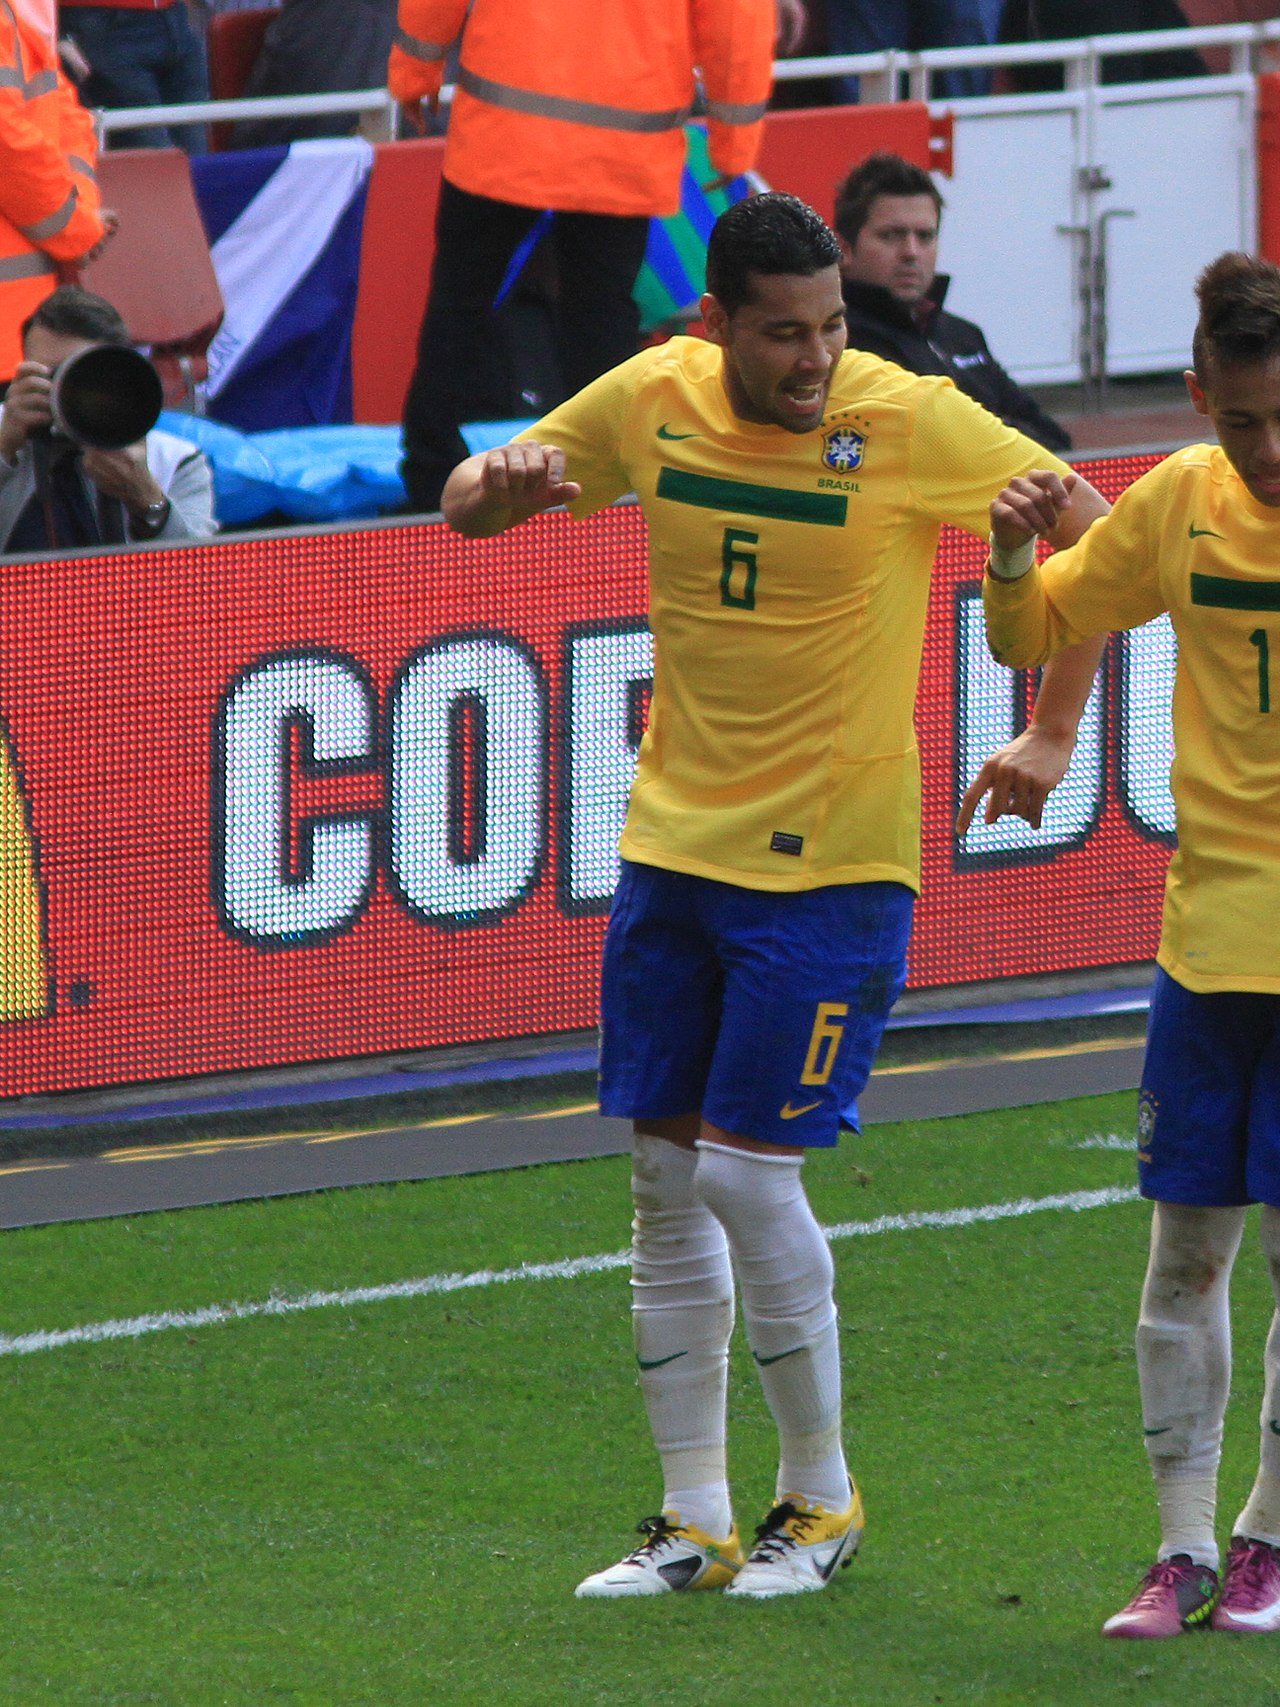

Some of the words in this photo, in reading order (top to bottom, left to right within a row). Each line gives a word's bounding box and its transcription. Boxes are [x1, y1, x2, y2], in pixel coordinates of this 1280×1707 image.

[817, 478, 862, 493] BRASIL
[719, 527, 759, 611] 6
[223, 630, 656, 939] COP
[799, 1001, 849, 1087] 6
